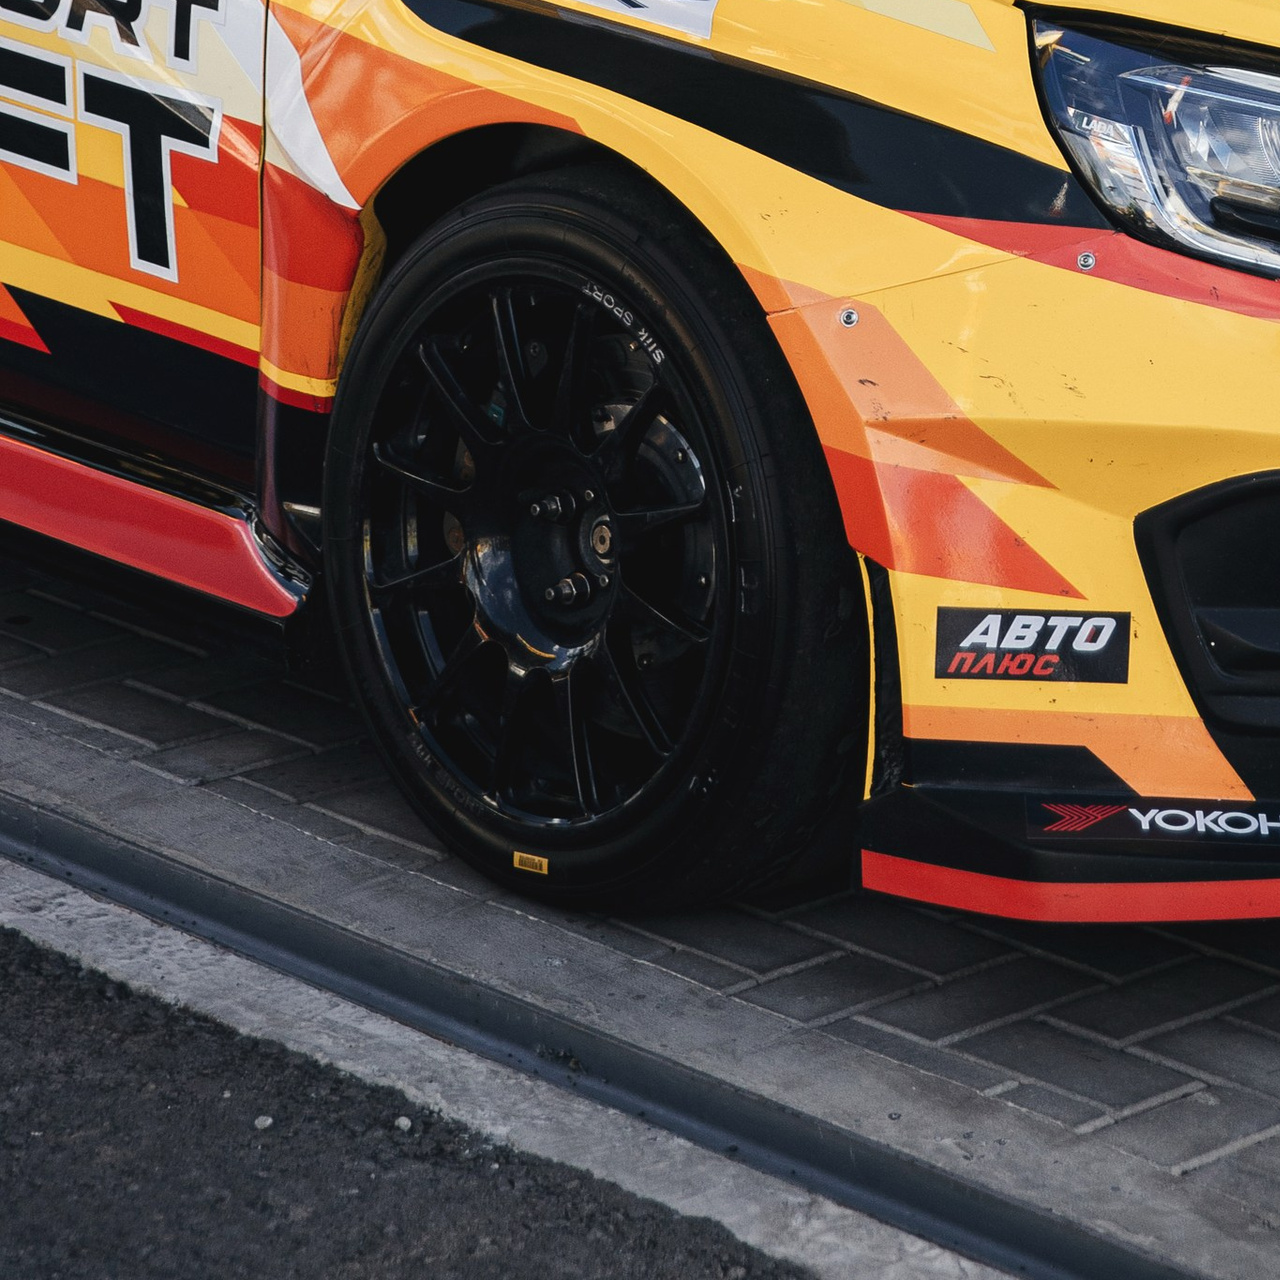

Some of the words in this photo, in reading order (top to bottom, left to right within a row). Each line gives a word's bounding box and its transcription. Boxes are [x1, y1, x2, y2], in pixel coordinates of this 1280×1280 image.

[1082, 116, 1114, 137] LADA
[582, 282, 634, 326] SPORT
[960, 614, 1118, 652] АВТО
[946, 652, 1061, 677] ПЛЮС
